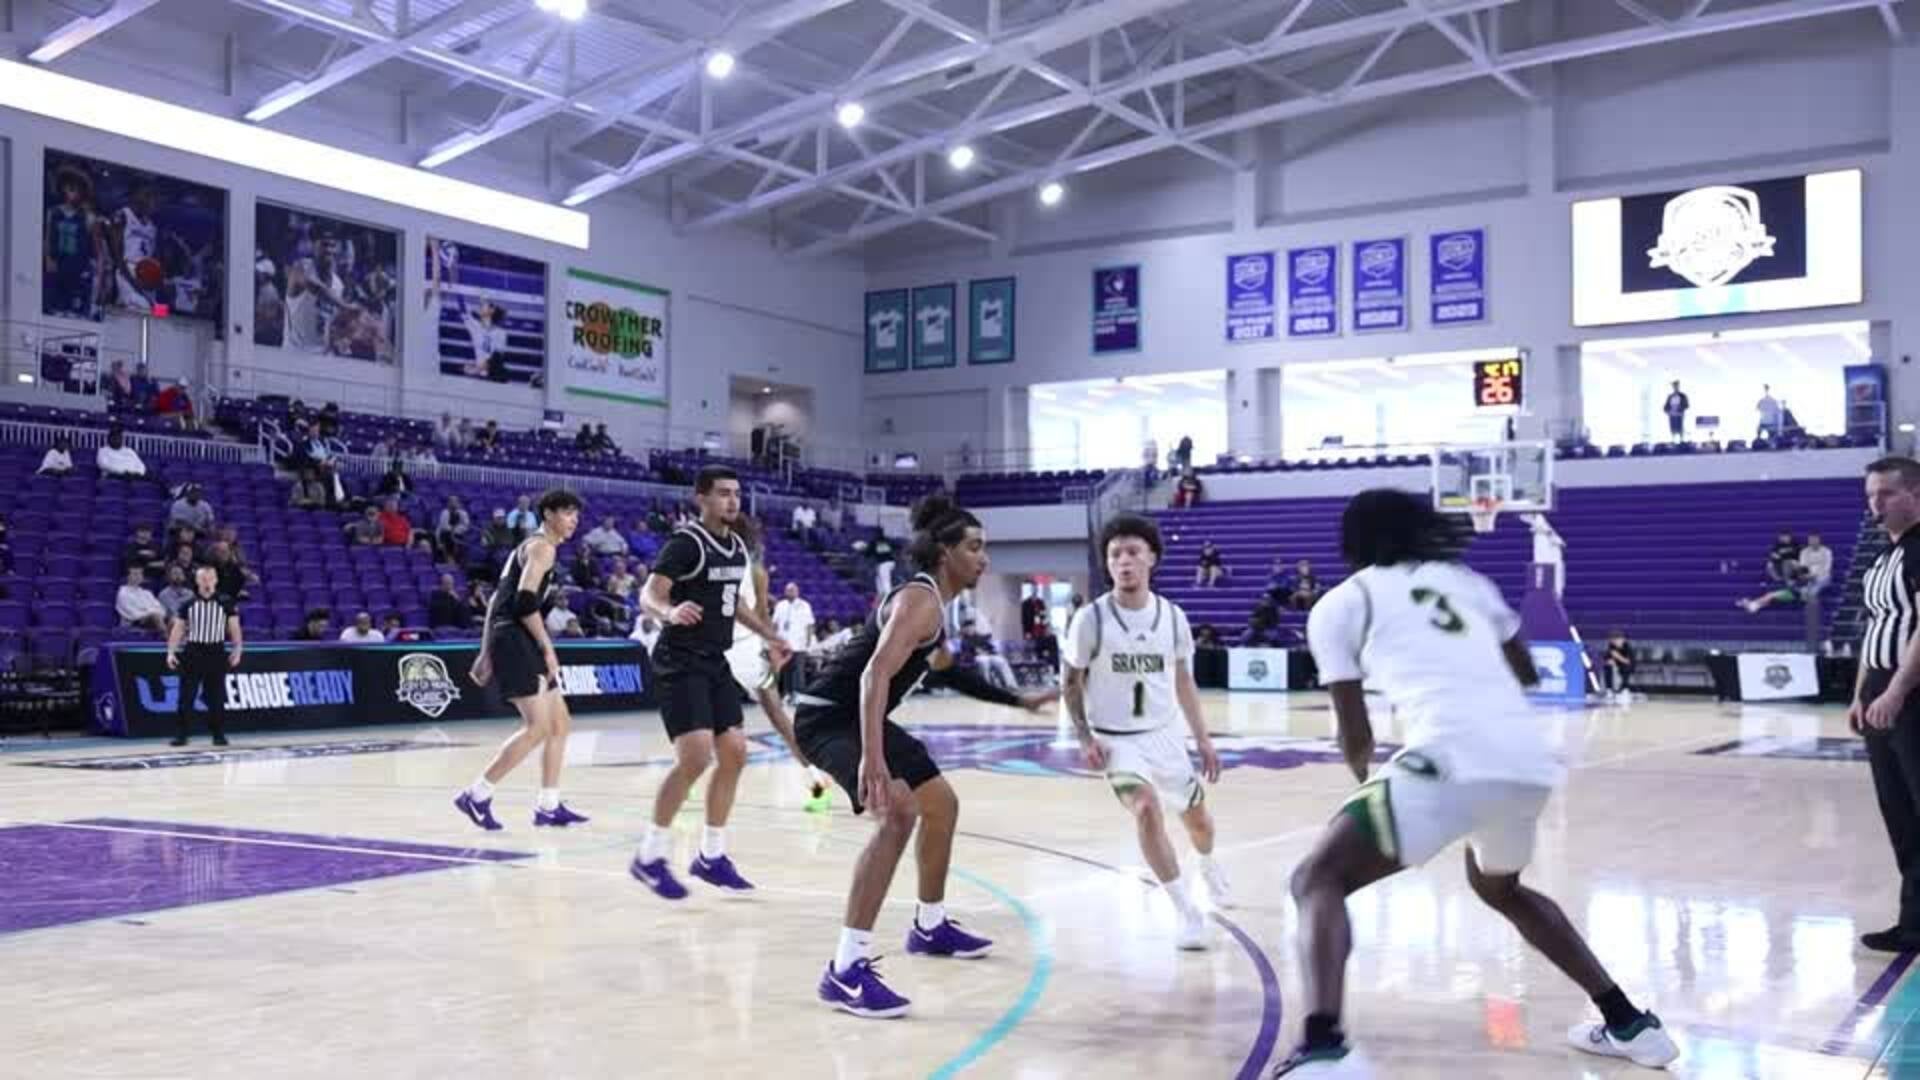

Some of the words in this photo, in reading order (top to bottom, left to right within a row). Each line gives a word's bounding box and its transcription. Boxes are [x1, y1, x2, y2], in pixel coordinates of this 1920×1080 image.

[566, 301, 662, 338] CROWTHER
[573, 325, 652, 358] ROOFING
[1411, 587, 1465, 634] 3
[1112, 653, 1164, 673] GRAYSON
[1132, 681, 1144, 717] 1
